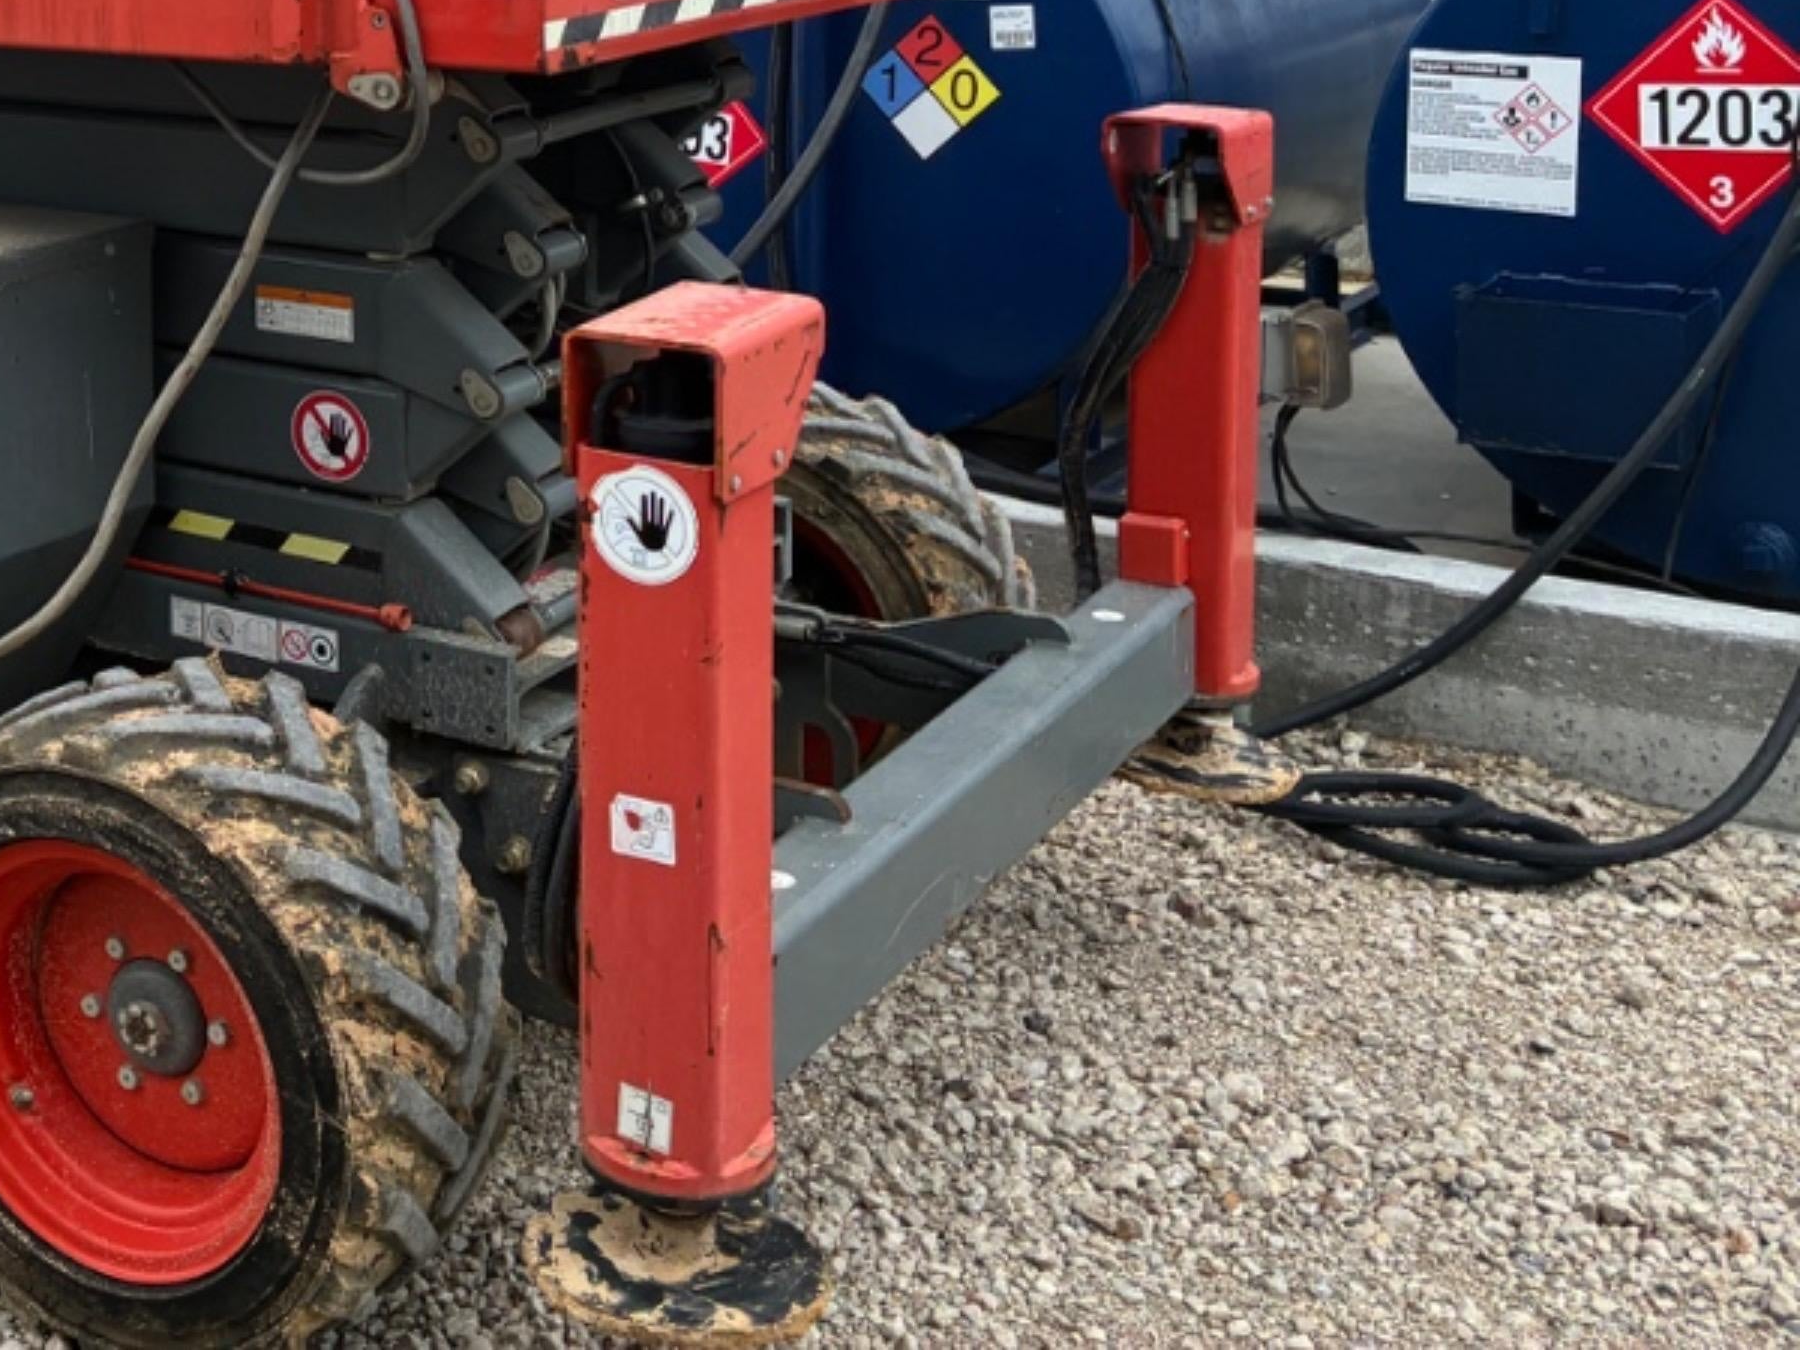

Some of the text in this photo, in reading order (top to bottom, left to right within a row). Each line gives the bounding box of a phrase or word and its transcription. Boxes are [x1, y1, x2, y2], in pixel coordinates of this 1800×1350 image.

[914, 25, 942, 67] 2
[881, 63, 979, 111] 1 0
[1649, 88, 1793, 147] 1203
[1709, 175, 1735, 208] 3
